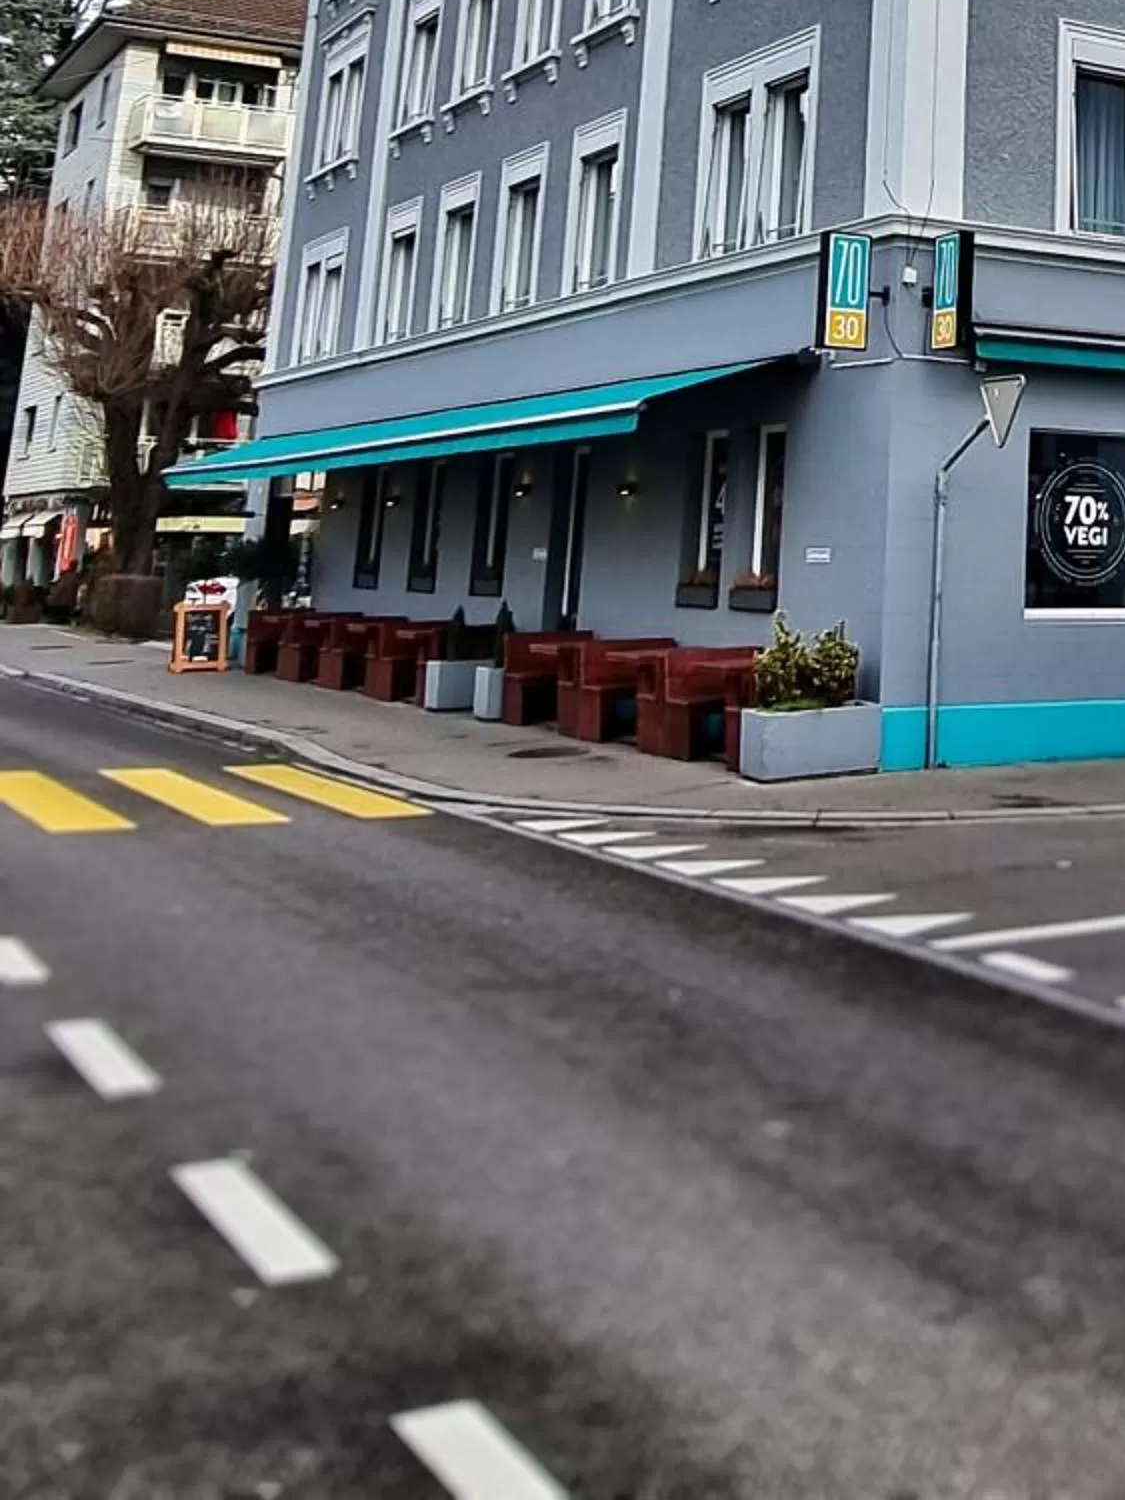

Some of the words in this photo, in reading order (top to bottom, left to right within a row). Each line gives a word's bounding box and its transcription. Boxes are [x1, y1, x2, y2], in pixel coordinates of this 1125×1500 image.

[835, 240, 862, 305] 70
[938, 241, 955, 306] 70
[832, 314, 860, 341] 30
[936, 314, 953, 342] 30
[1064, 495, 1109, 525] 70%
[1064, 525, 1108, 546] VEGI
